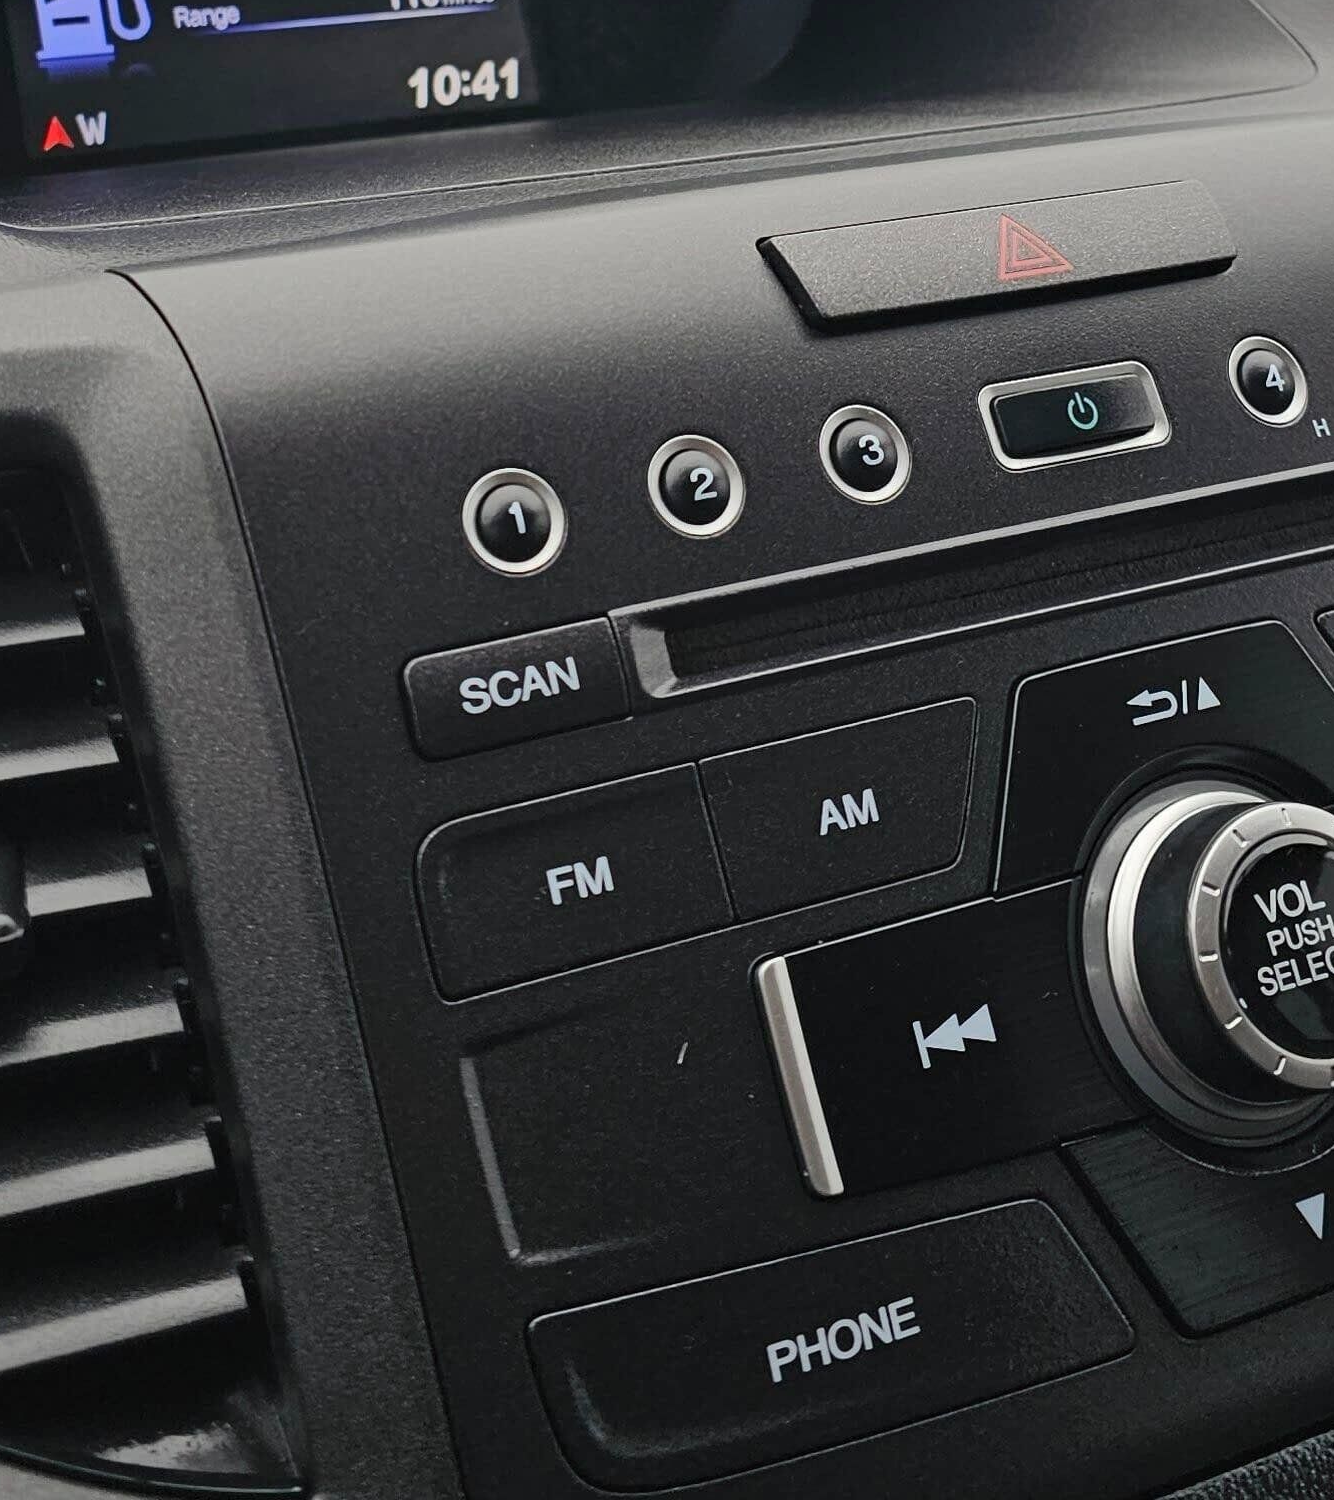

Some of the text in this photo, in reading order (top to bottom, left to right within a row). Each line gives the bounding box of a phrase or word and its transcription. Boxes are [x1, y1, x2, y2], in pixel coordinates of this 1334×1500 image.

[172, 4, 241, 31] Range
[408, 57, 520, 109] 10:41
[76, 111, 107, 146] W
[1264, 363, 1286, 393] 4
[1311, 417, 1331, 438] H
[857, 433, 886, 467] 3
[689, 466, 719, 502] 2
[507, 500, 528, 535] 1
[458, 656, 581, 715] SCAN
[819, 788, 880, 836] AM
[545, 855, 615, 906] FM
[1253, 880, 1330, 925] VOL
[766, 1296, 921, 1383] PHONE
